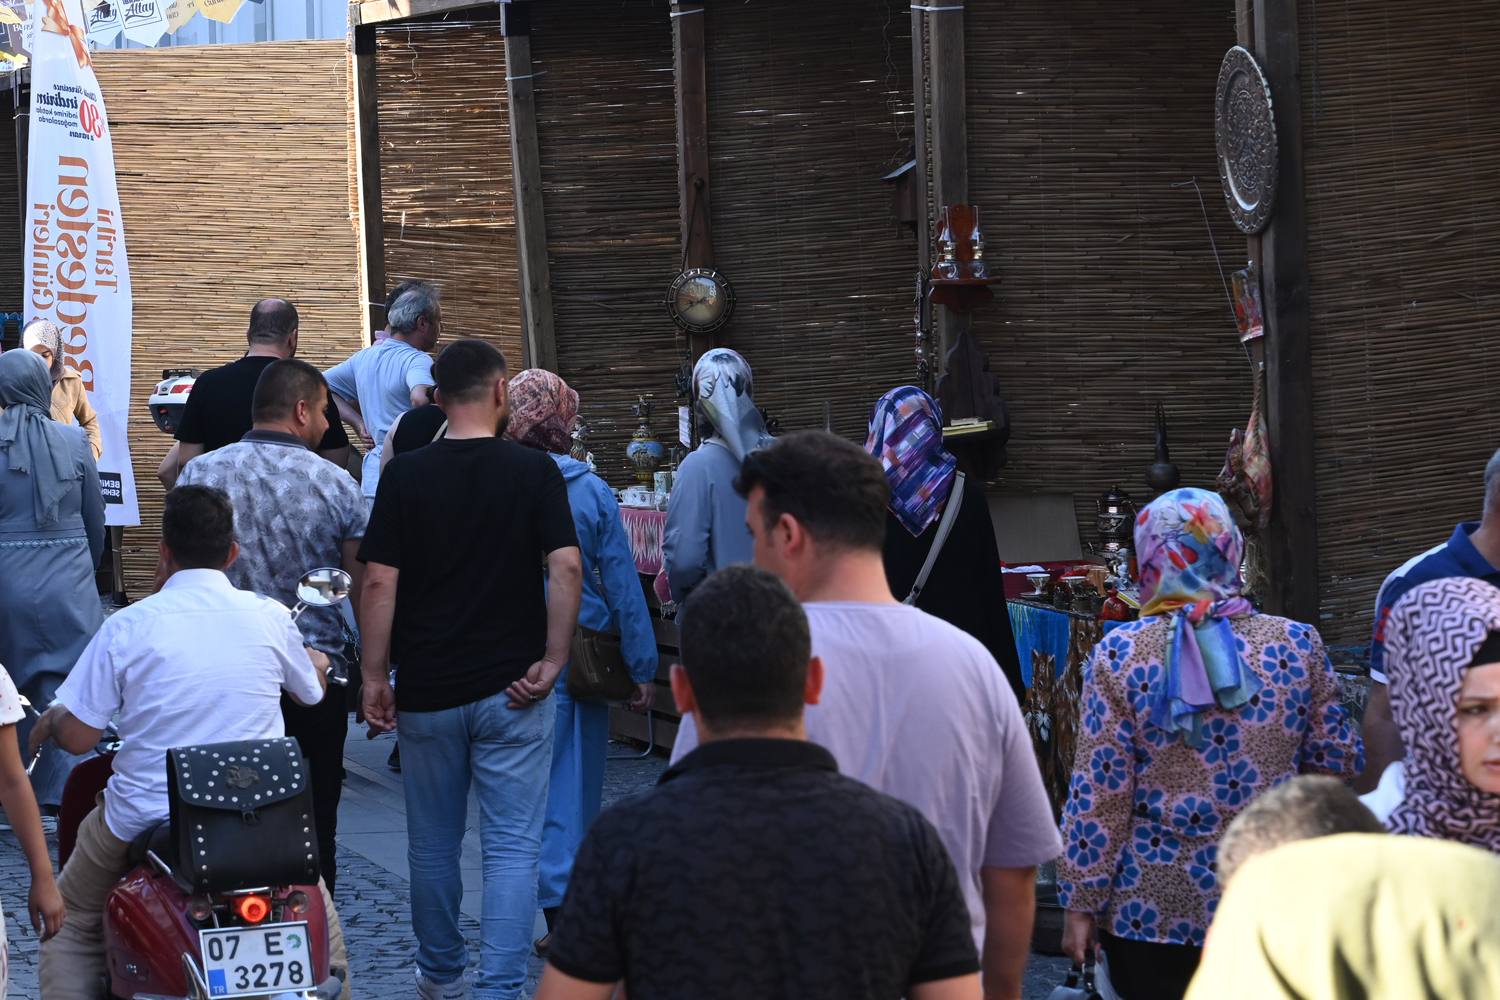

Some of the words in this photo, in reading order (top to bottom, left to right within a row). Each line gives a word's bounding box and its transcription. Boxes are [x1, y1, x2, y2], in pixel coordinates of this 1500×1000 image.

[208, 935, 239, 961] 07
[264, 932, 283, 955] E
[234, 961, 304, 989] 3278
